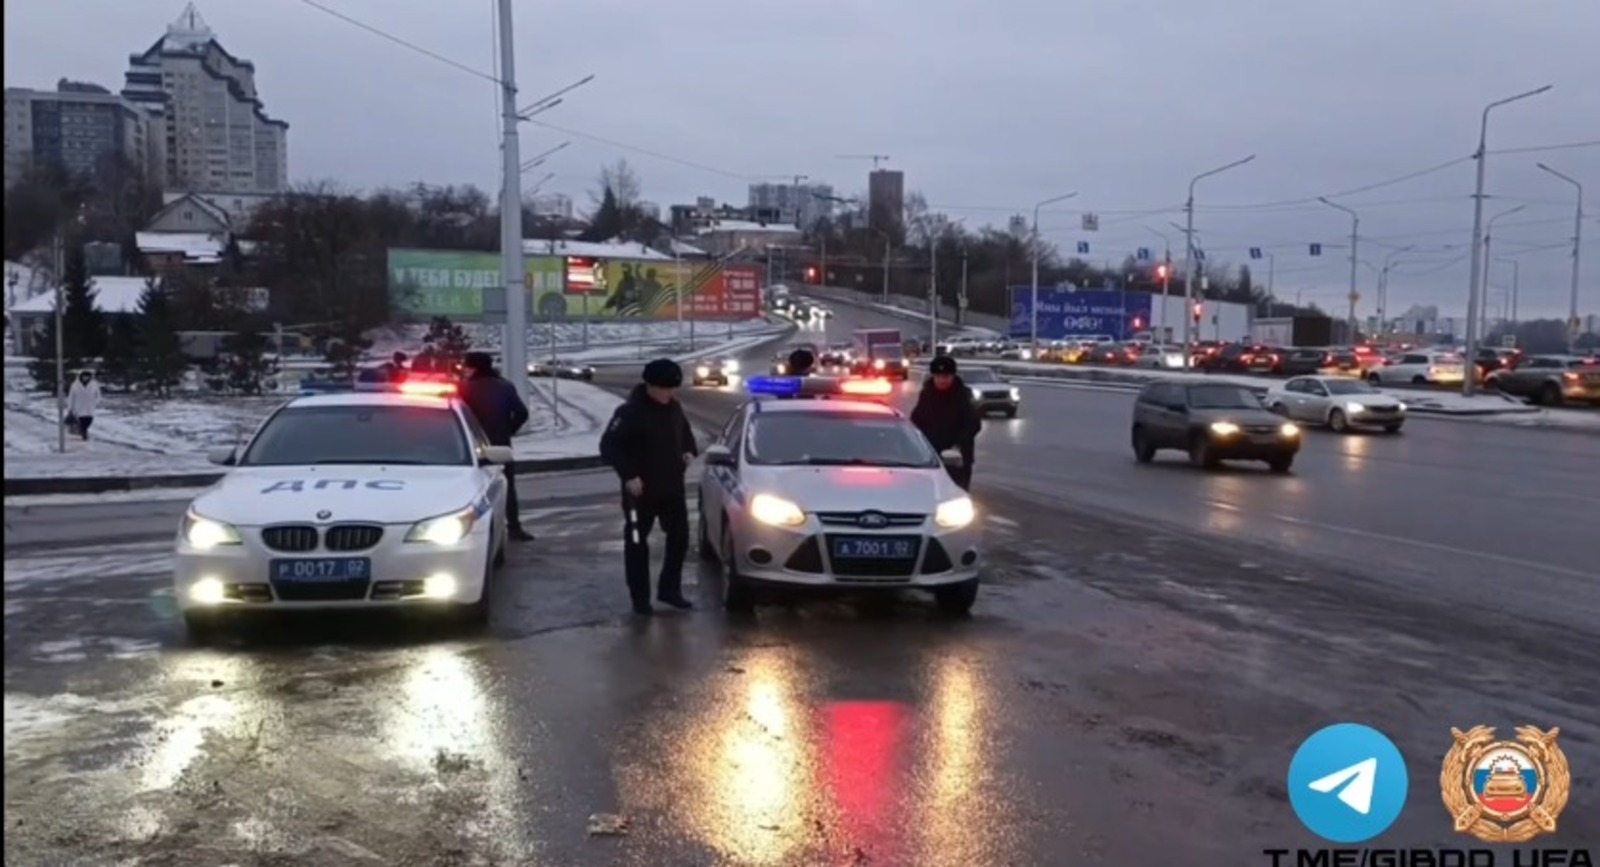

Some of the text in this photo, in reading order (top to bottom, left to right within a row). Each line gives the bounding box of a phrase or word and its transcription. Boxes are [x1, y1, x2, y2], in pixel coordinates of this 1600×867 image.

[409, 267, 450, 289] ТЕБЯ
[454, 269, 500, 289] БУДЕТ
[260, 480, 406, 494] ДПС
[854, 541, 888, 554] 7001
[895, 541, 909, 553] 02
[294, 561, 335, 576] 0017
[347, 560, 364, 572] 02
